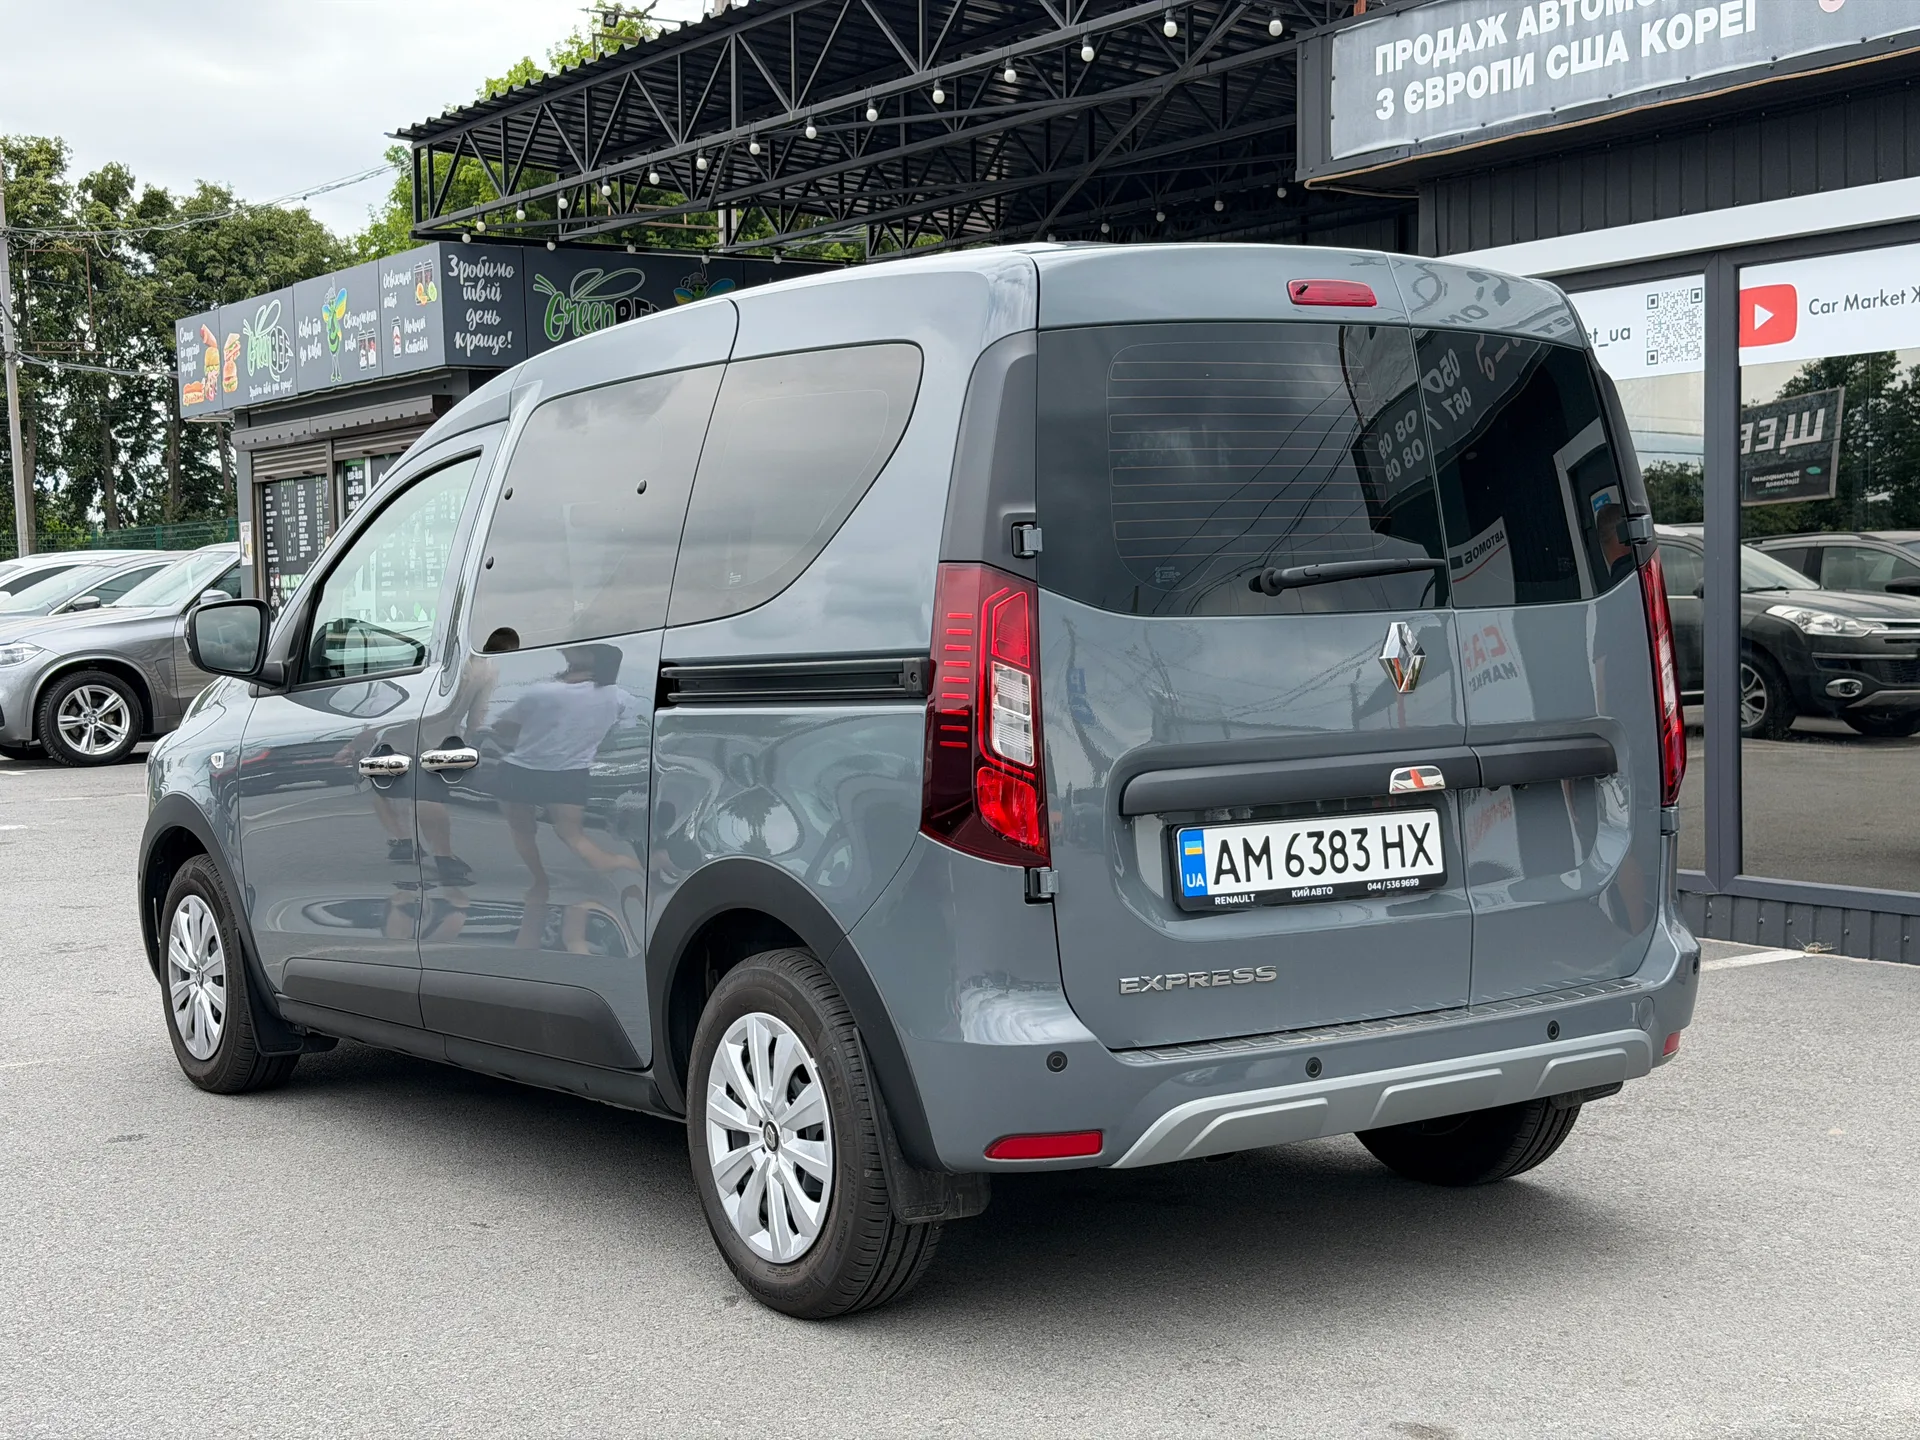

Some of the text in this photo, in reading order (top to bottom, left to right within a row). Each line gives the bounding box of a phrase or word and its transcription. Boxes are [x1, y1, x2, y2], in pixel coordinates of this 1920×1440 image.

[1375, 0, 1669, 76] ПРОДАЖ АВТО
[1375, 88, 1394, 120] З
[1403, 52, 1534, 114] ЄВРОПИ
[1546, 29, 1629, 80] США
[448, 254, 515, 285] Зробимо
[463, 278, 502, 303] твій
[1809, 298, 1839, 315] Car
[1844, 289, 1906, 311] Market
[466, 308, 501, 331] день
[454, 331, 512, 357] краще!
[1213, 835, 1273, 886] AM
[1284, 826, 1371, 878] 6383
[1380, 822, 1435, 870] HX
[1186, 873, 1205, 888] UA
[1214, 894, 1255, 905] RENAULT
[1119, 965, 1277, 995] EXPRESS
